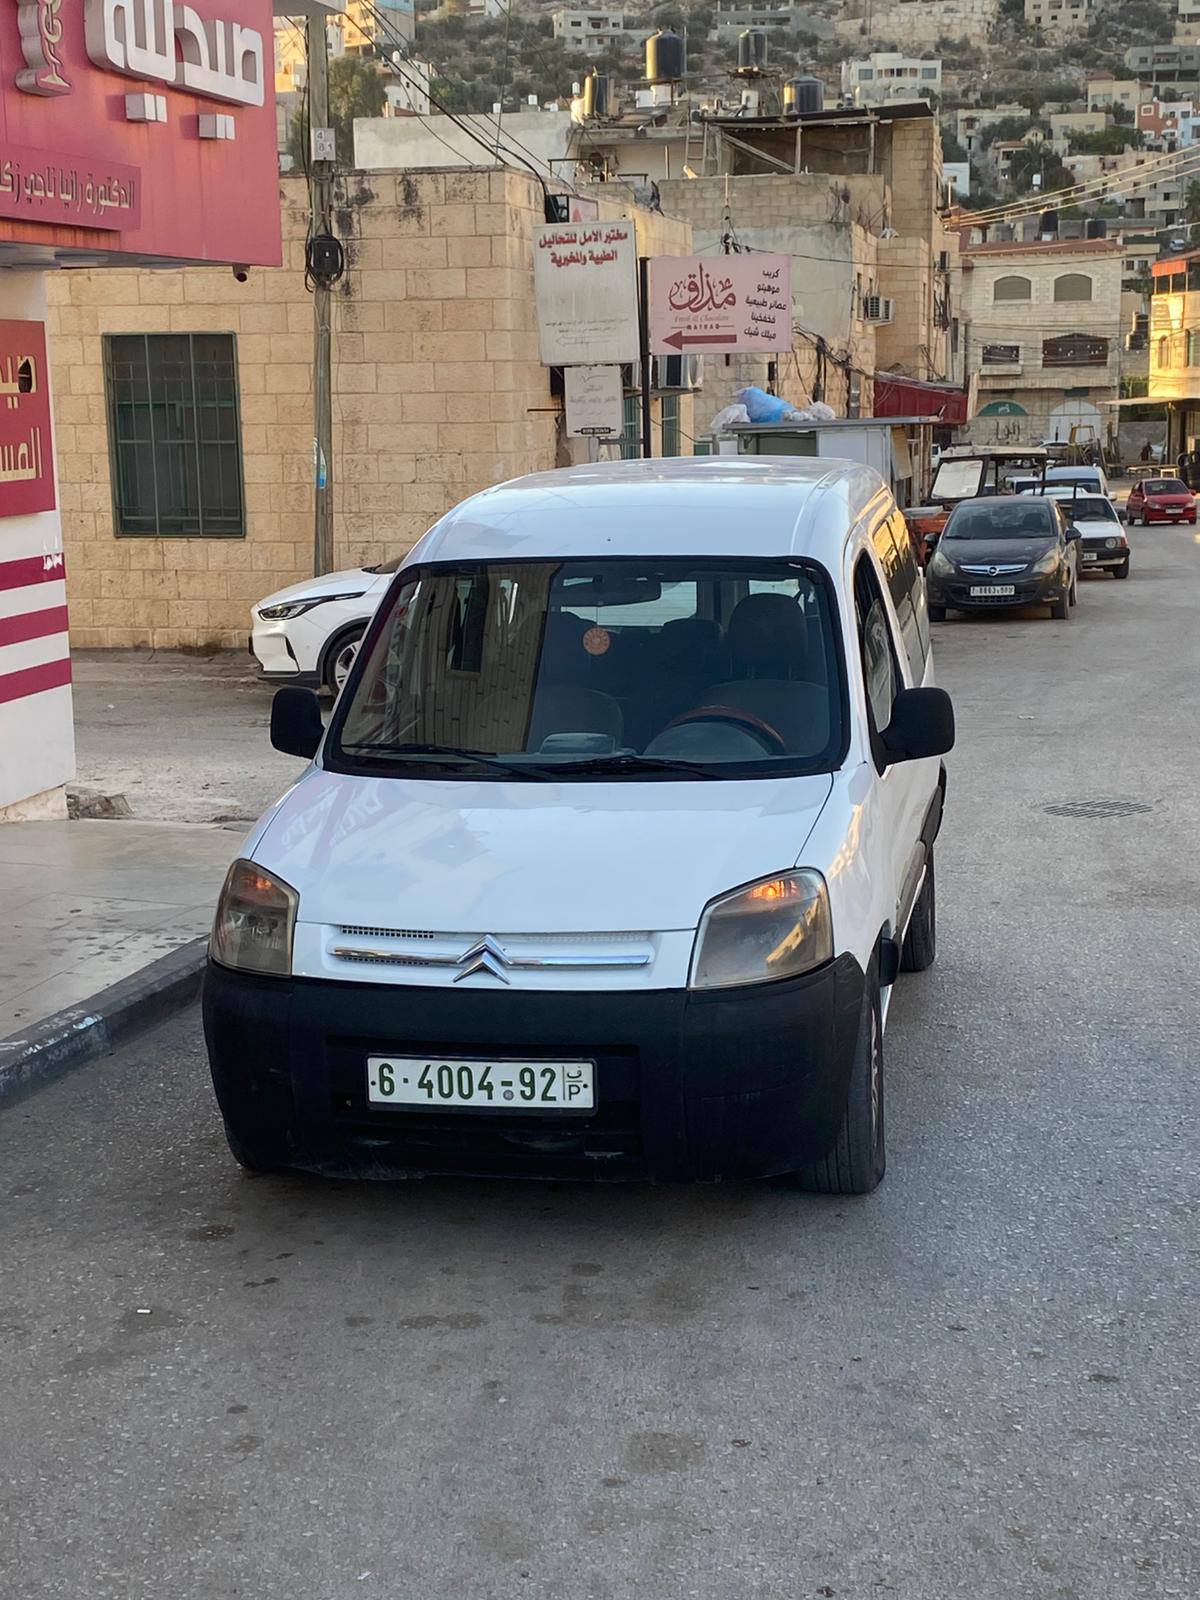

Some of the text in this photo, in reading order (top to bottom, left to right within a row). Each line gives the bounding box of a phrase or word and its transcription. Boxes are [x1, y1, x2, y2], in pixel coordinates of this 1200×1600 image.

[24, 164, 57, 206] ناجي
[60, 167, 84, 213] رانيا
[85, 173, 136, 216] الدكتورة
[538, 232, 578, 249] للتحاليل
[604, 228, 629, 244] مختبر
[550, 249, 618, 268] الطبية والمخبرية
[568, 1084, 581, 1101] P
